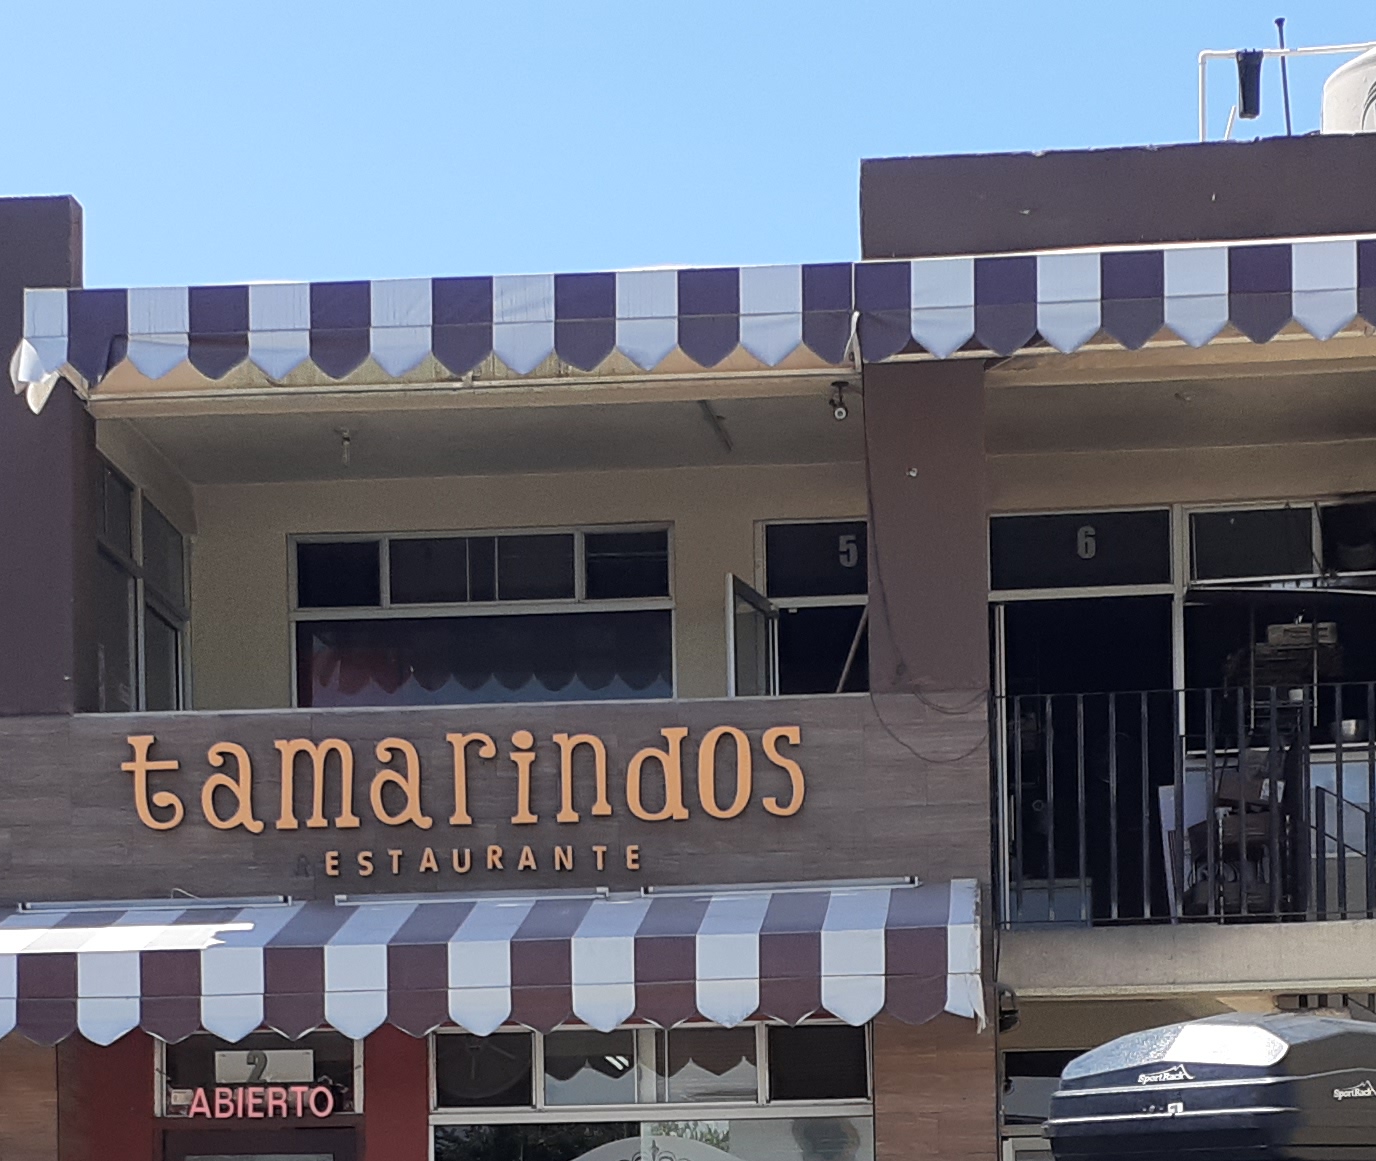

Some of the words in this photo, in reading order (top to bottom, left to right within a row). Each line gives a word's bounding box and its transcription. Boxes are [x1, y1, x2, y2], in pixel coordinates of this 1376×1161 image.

[838, 535, 858, 568] 5
[1077, 525, 1096, 559] 6
[246, 1050, 268, 1083] 2
[1138, 1070, 1185, 1083] SportRack
[189, 1087, 334, 1119] ABIERTO
